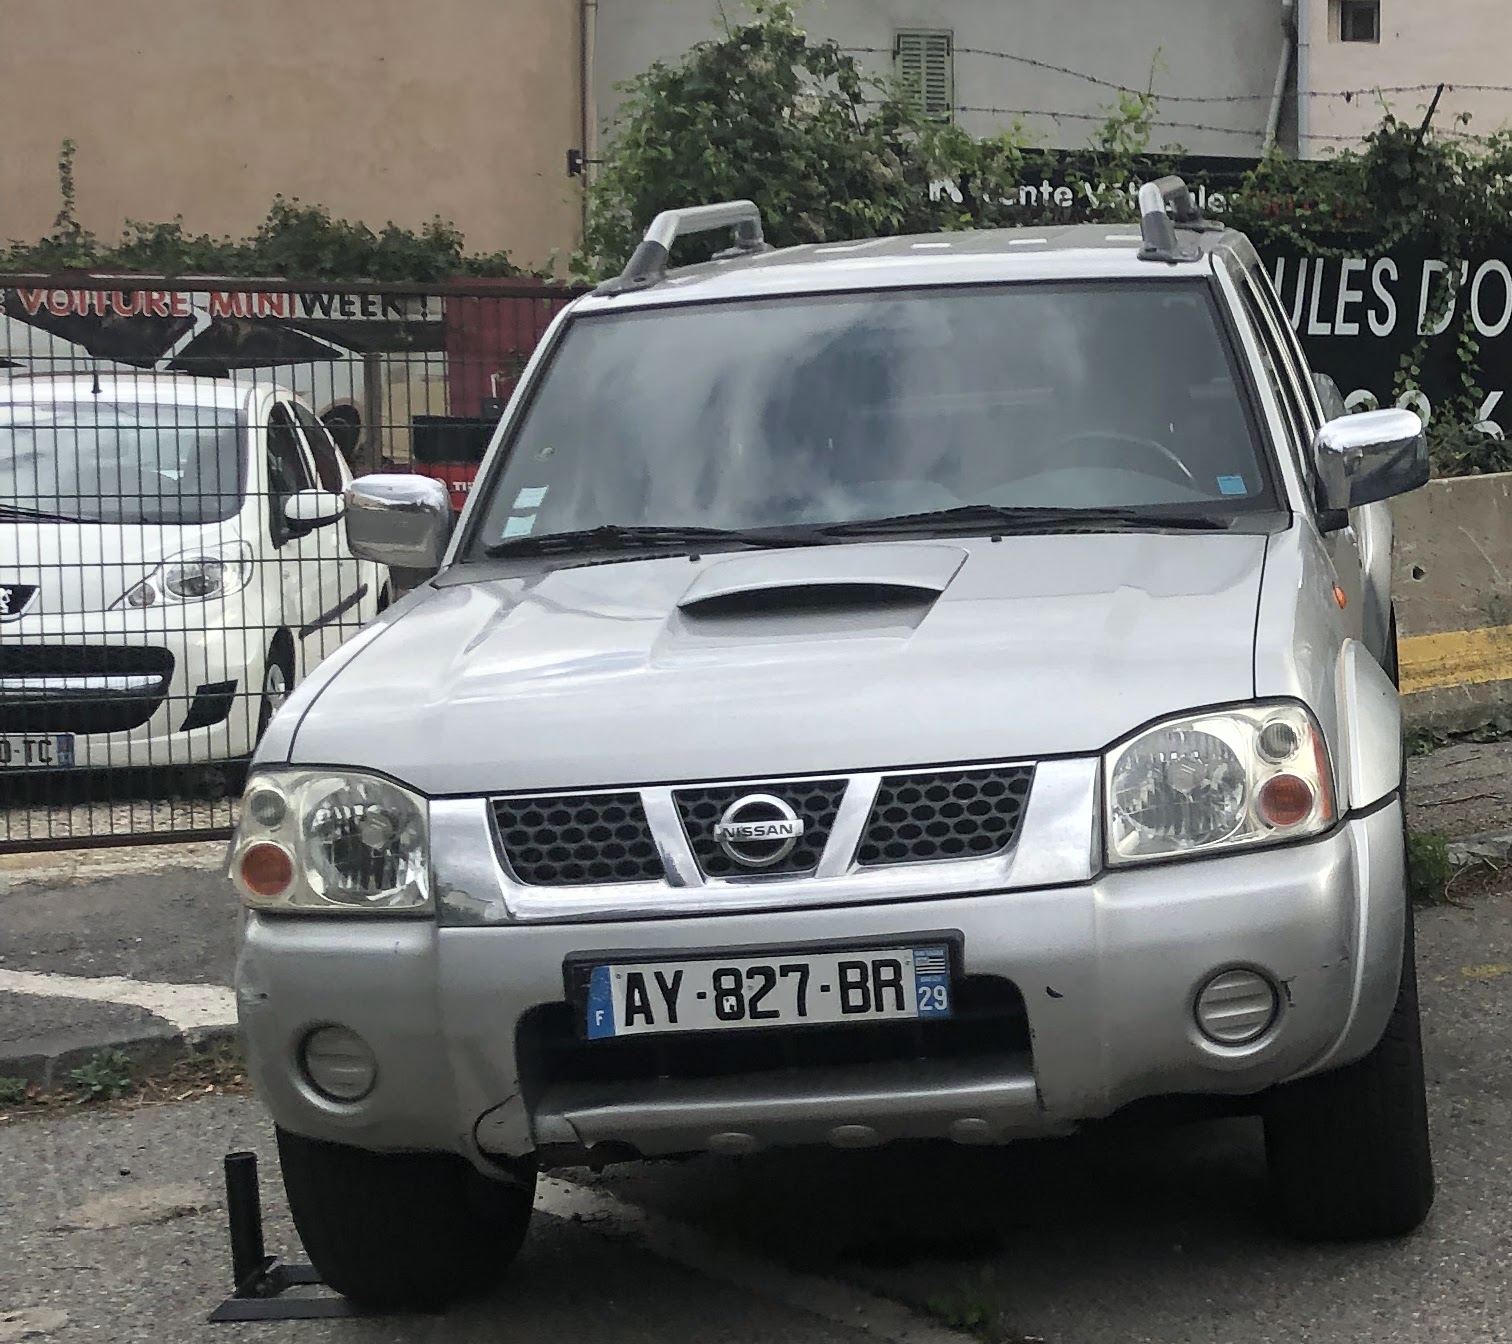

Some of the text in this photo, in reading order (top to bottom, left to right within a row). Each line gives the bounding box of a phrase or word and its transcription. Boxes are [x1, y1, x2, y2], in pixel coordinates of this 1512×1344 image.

[723, 823, 793, 838] NISSAN
[595, 1010, 605, 1026] F
[918, 985, 948, 1011] 29
